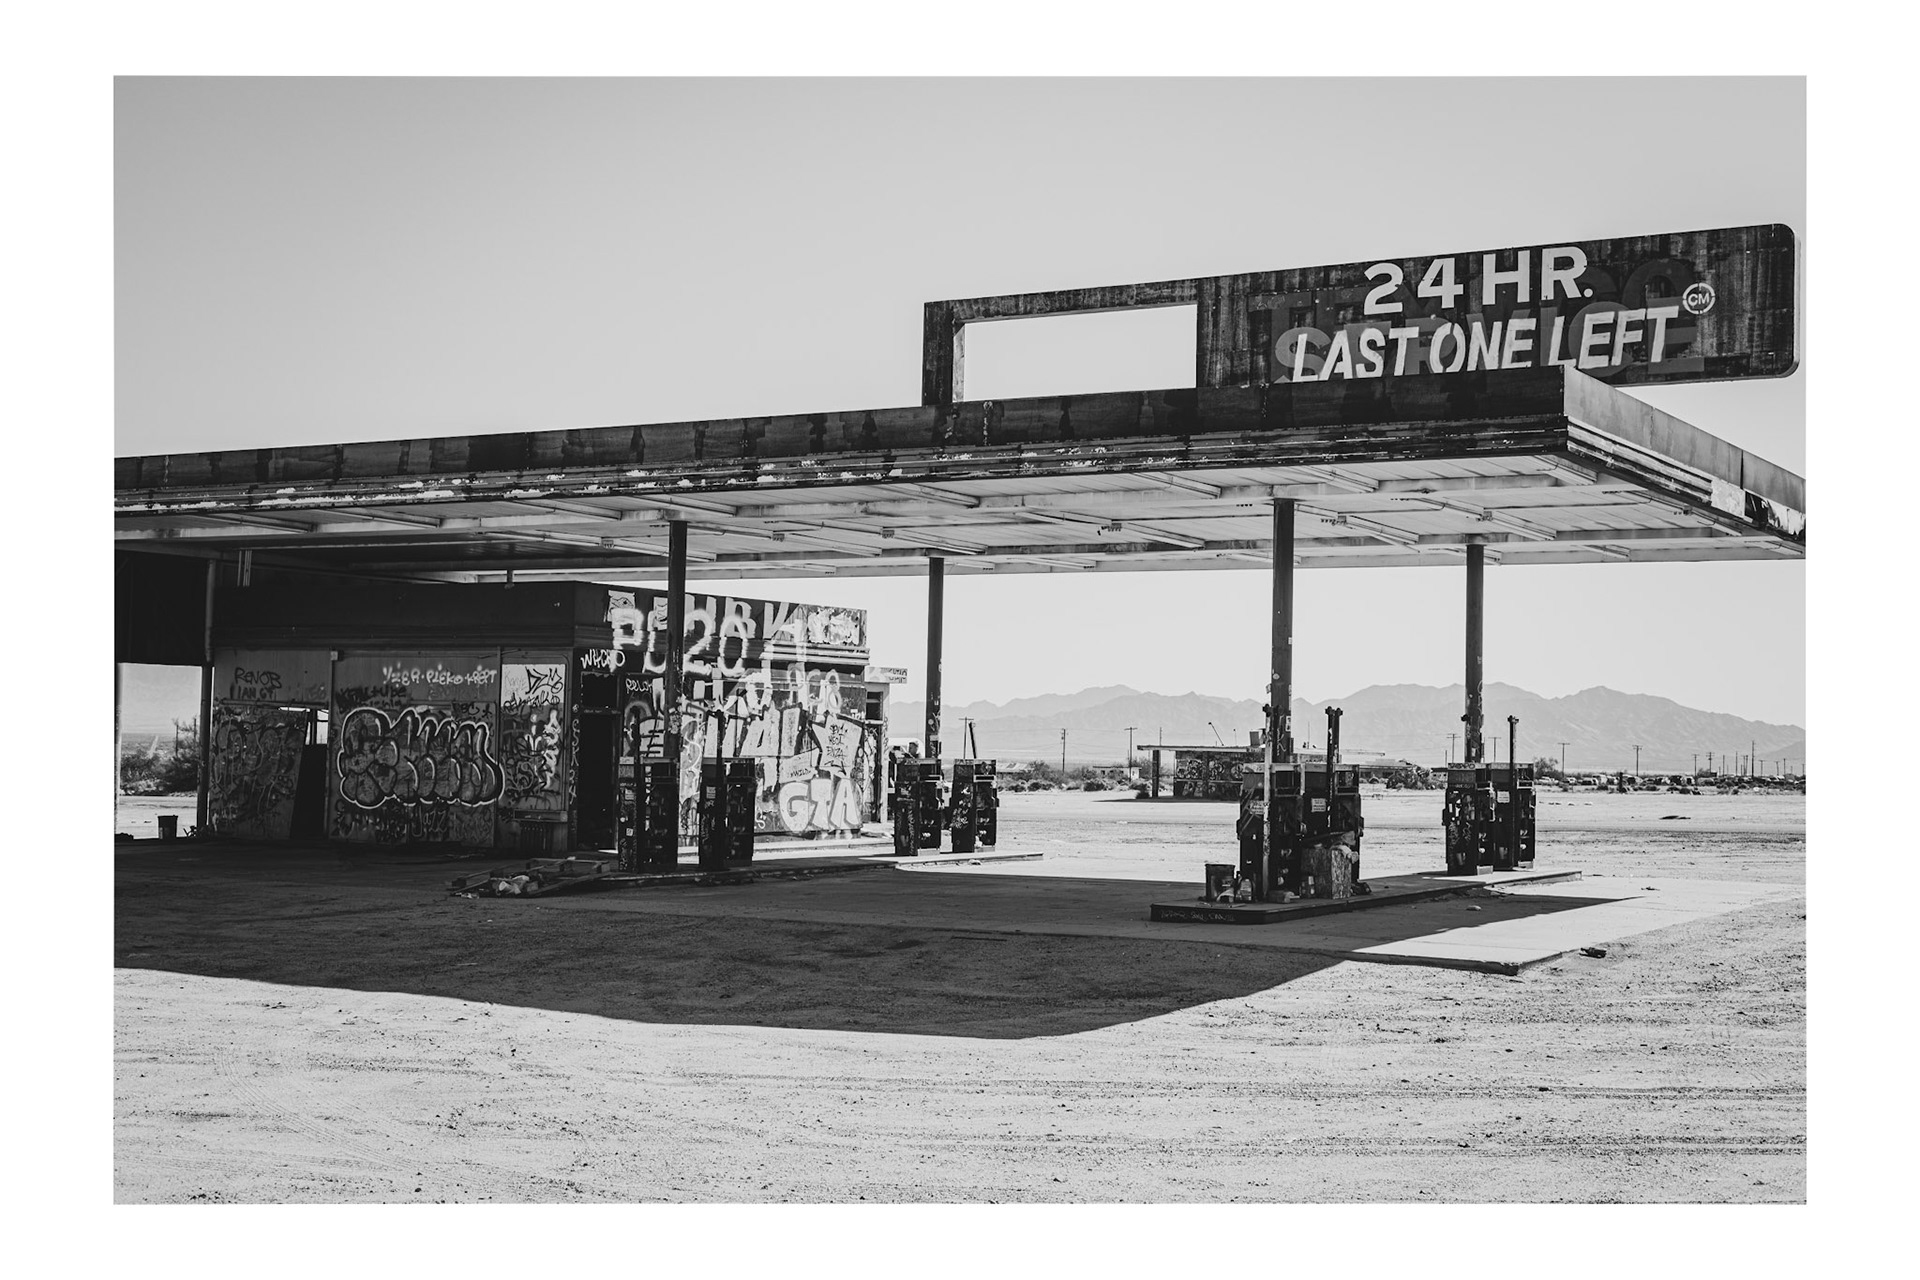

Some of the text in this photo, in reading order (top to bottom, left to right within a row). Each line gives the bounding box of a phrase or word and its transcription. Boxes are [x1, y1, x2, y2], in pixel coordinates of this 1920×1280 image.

[1364, 257, 1464, 316] 24
[1481, 246, 1595, 306] HR.
[1292, 305, 1679, 384] LAST ONE LEFT
